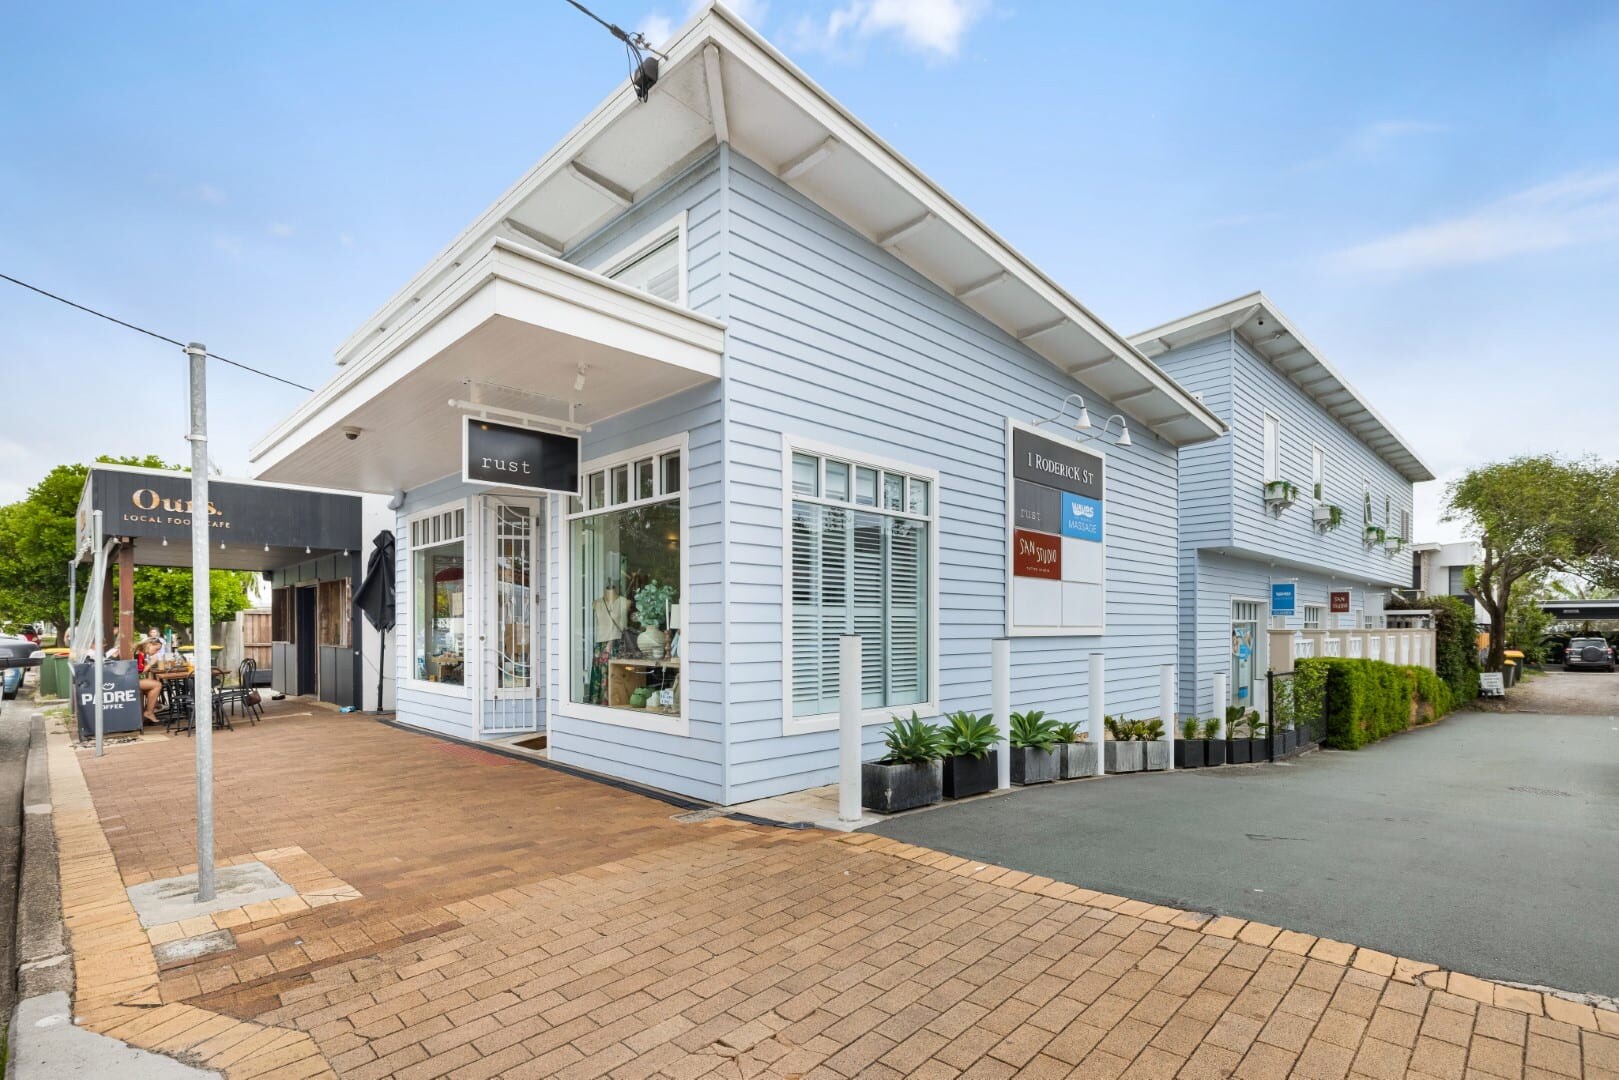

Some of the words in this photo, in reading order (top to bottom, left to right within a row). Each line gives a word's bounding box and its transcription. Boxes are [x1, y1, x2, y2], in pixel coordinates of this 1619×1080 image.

[481, 457, 531, 474] rust
[1028, 452, 1032, 467] 1
[123, 513, 162, 524] LOCAL
[167, 517, 192, 526] FOO
[1068, 519, 1097, 534] MASSAGE
[81, 689, 137, 706] PDRE
